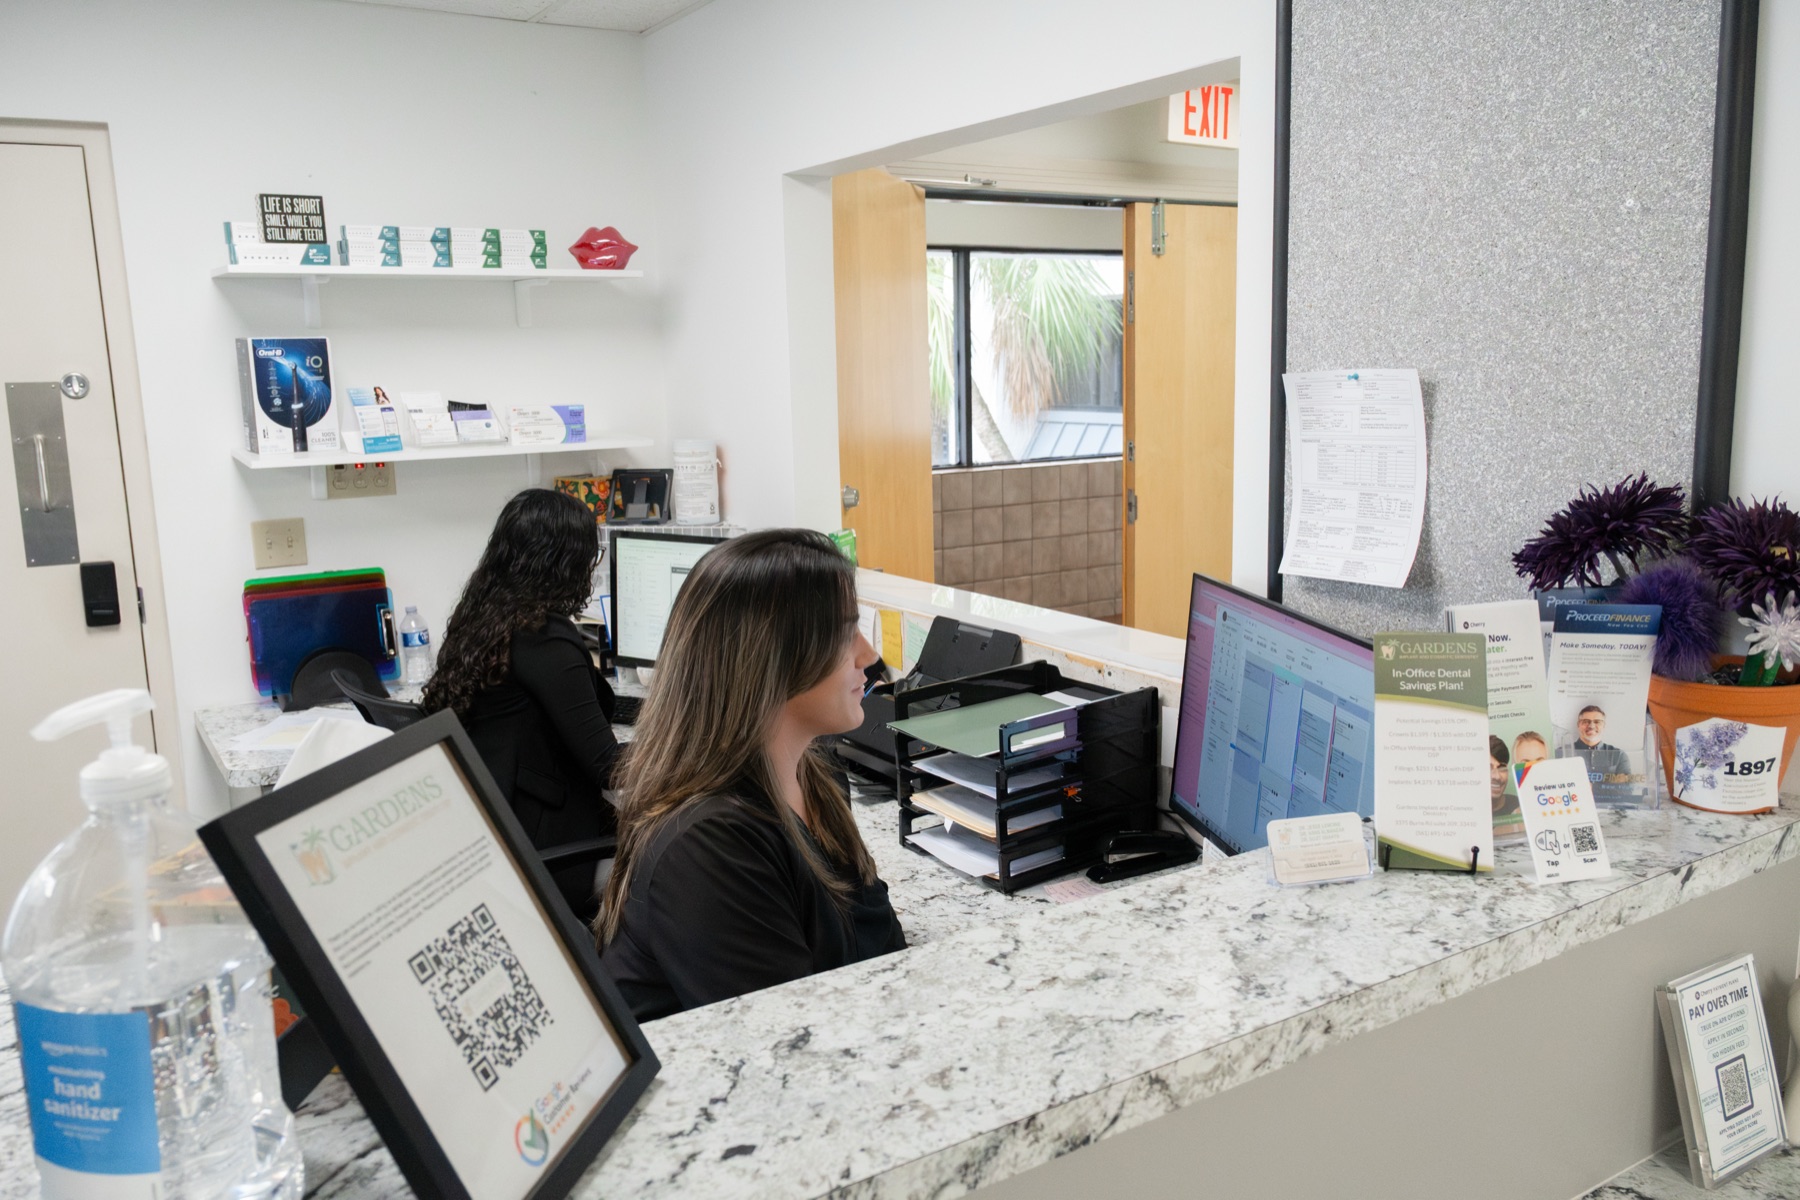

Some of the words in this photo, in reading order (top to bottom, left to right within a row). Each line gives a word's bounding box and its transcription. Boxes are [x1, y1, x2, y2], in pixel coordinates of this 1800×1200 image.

[1184, 85, 1233, 139] EXIT
[263, 196, 282, 213] LIFE
[282, 197, 292, 213] IS
[293, 198, 321, 214] SHORT
[265, 214, 286, 227] SMILE
[286, 214, 308, 228] WHILE
[308, 215, 322, 228] YOU
[266, 227, 286, 241] STILL
[286, 228, 304, 241] HAVE
[304, 228, 324, 242] TEETH
[258, 349, 282, 357] Oral-B
[1566, 610, 1651, 623] PROCEEDFINANCE
[1488, 634, 1511, 643] Now.
[1400, 642, 1478, 654] GARDENS
[1486, 646, 1507, 654] ater.
[1392, 668, 1436, 678] In-Office
[1438, 668, 1471, 678] Dental
[1400, 681, 1436, 692] Savings
[1439, 681, 1464, 690] Plan!
[1724, 757, 1776, 776] 1897
[1534, 784, 1556, 792] Review
[1537, 790, 1578, 806] Google
[329, 774, 443, 852] GARDENS
[1688, 1003, 1705, 1021] PAY
[1706, 994, 1729, 1013] OVER
[1728, 985, 1749, 1004] TIME
[1700, 1022, 1712, 1032] TRUE
[1719, 1016, 1728, 1025] APR
[1728, 1008, 1746, 1021] OPTIONS
[1707, 1036, 1720, 1046] APPLY
[1721, 1032, 1726, 1040] IN
[1726, 1024, 1745, 1038] SECONDS
[1712, 1051, 1720, 1060] NO
[1720, 1044, 1736, 1055] HIDDEN
[1736, 1039, 1746, 1048] FEES
[53, 1076, 102, 1100] hand
[43, 1098, 122, 1122] sanitizer
[543, 1092, 571, 1125] Customer
